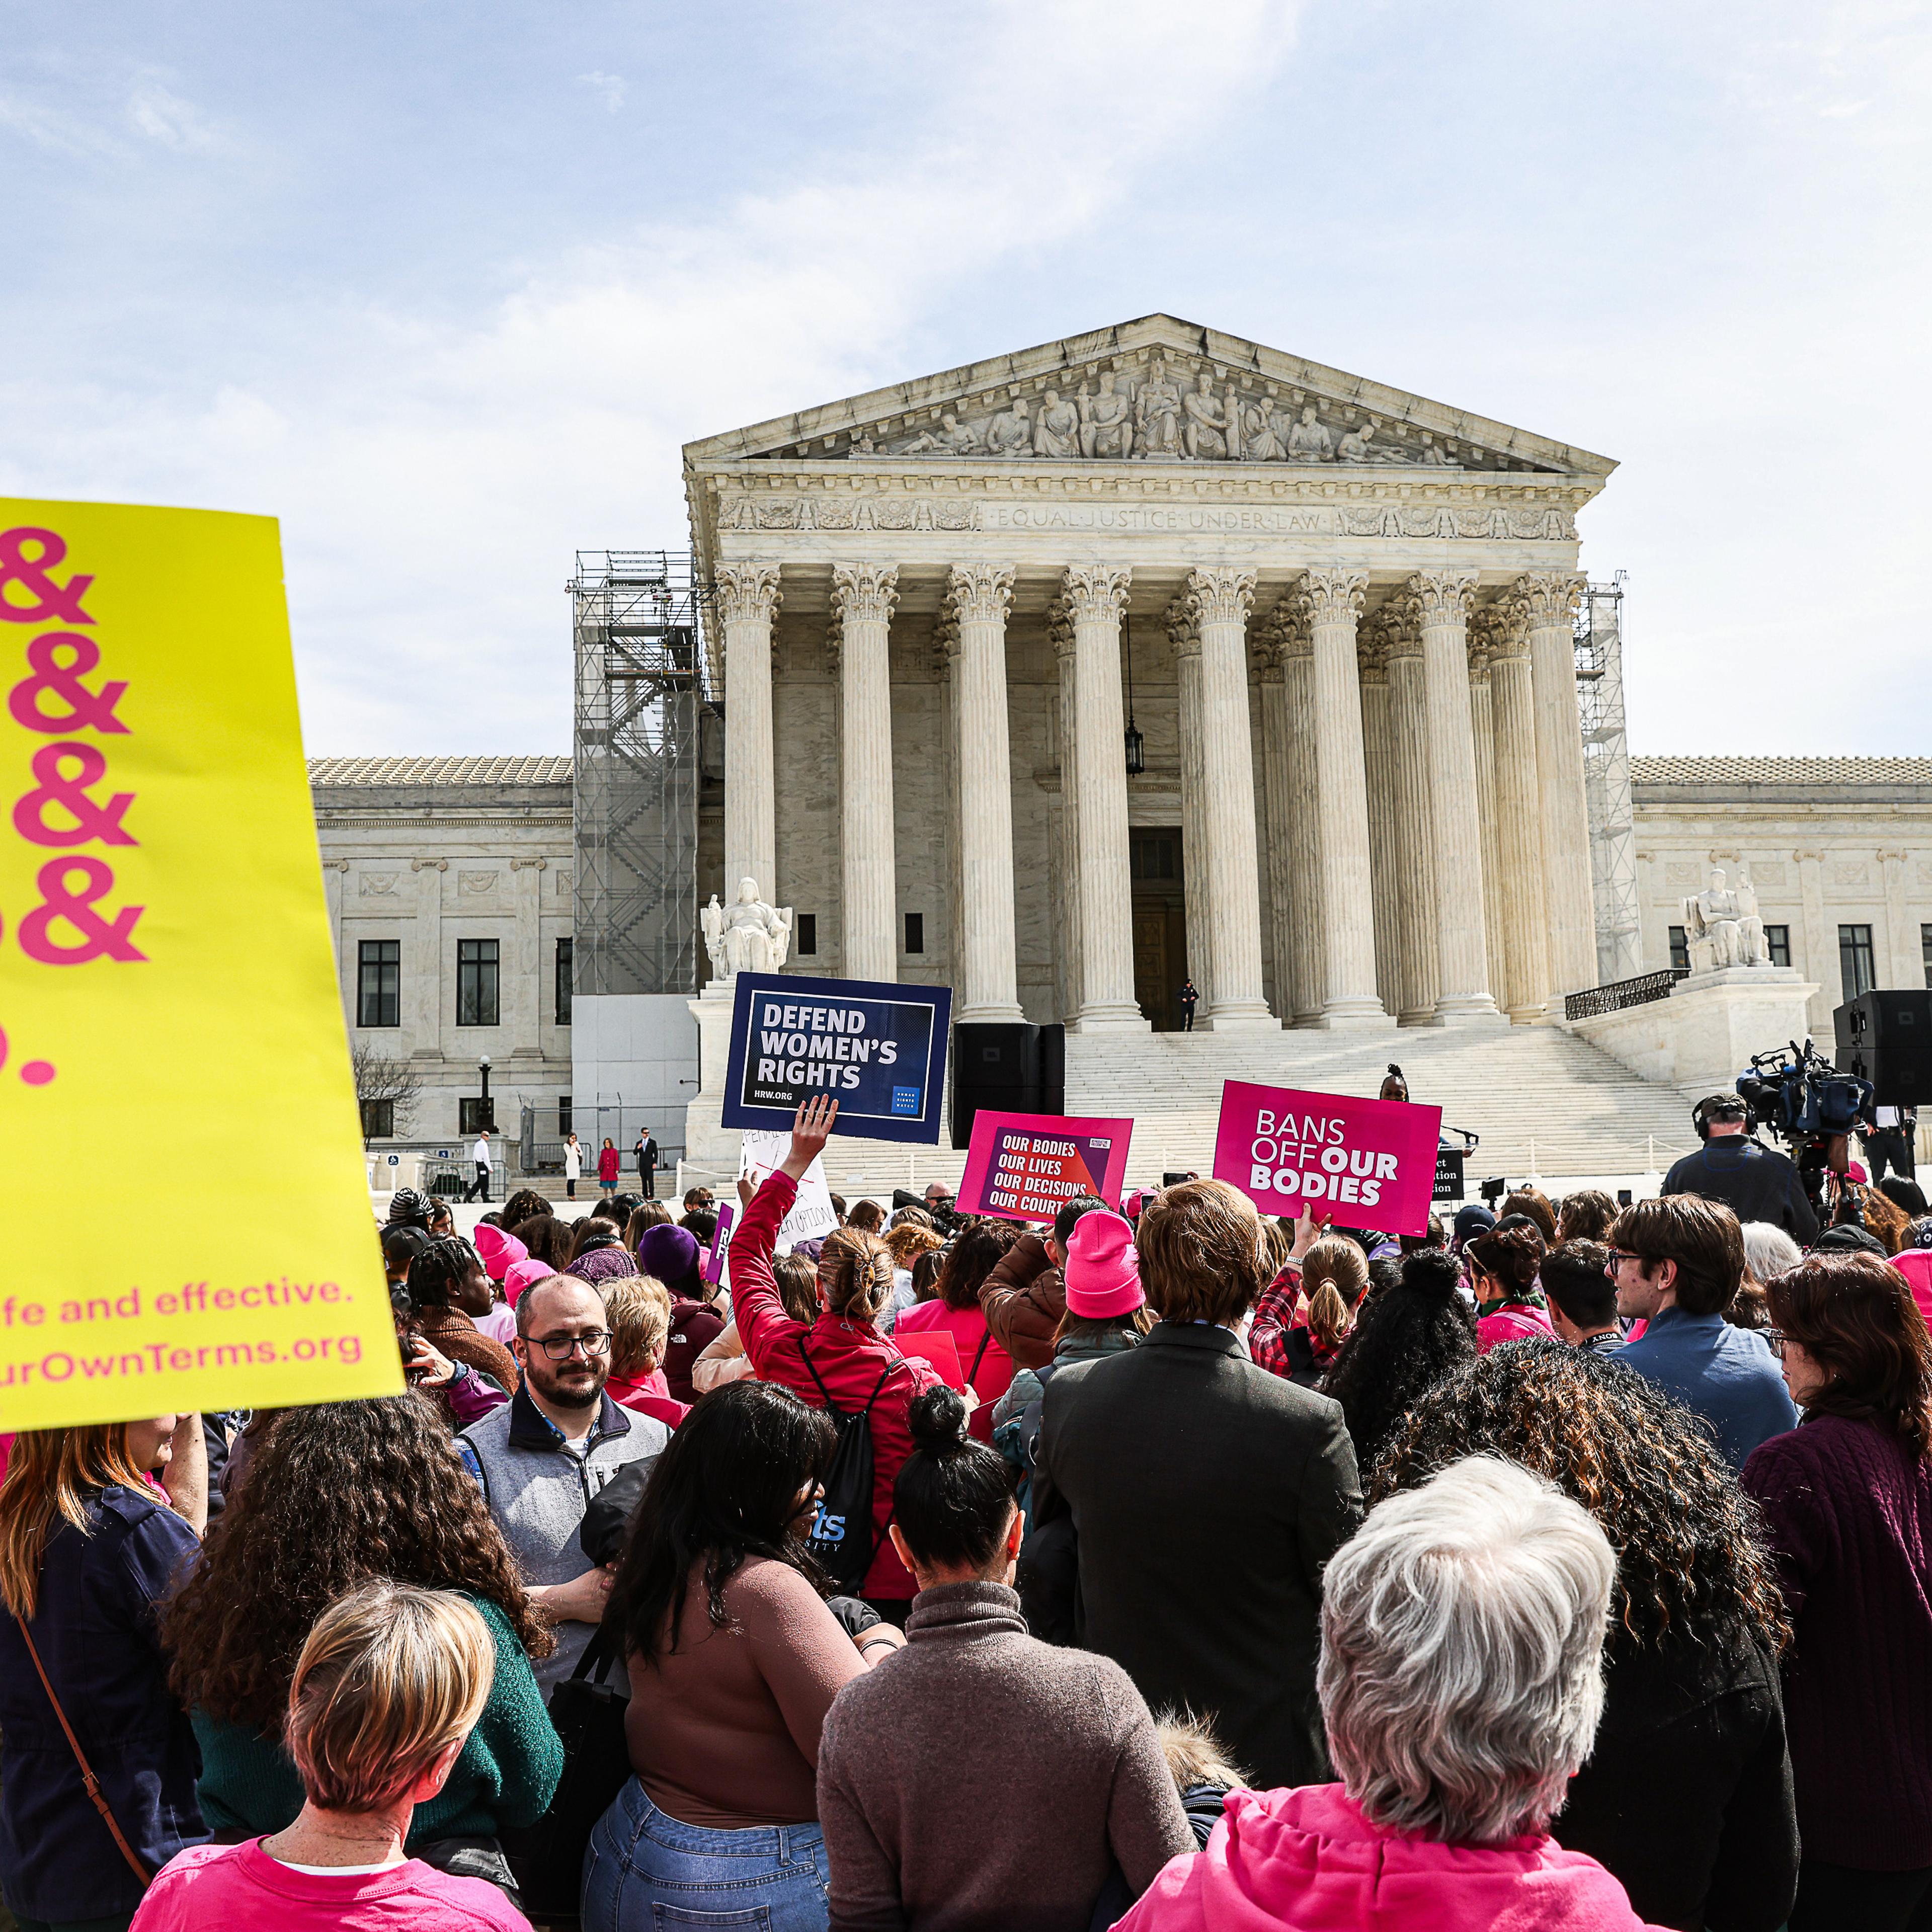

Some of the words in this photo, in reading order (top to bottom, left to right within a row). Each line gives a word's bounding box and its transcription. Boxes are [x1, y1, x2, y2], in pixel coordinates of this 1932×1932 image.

[999, 509, 1079, 527] EQUAL
[1084, 510, 1177, 528] JUSTICE
[1189, 512, 1269, 529] UNDER
[1276, 513, 1320, 530] LAW
[9, 631, 131, 734] &
[13, 742, 139, 848] &
[763, 1004, 865, 1034] DEFEND
[760, 1030, 898, 1064] WOMEN'S
[757, 1058, 860, 1089] RIGHTS
[754, 1090, 792, 1100] HRW.ORG
[1256, 1109, 1345, 1145] BANS
[1002, 1135, 1029, 1152] OUR
[1032, 1139, 1076, 1157] BODIES
[998, 1154, 1026, 1171] OUR
[1028, 1158, 1062, 1175] LIVES
[1251, 1137, 1317, 1168] OFF
[1321, 1147, 1398, 1181] OUR
[994, 1172, 1022, 1189] OUR
[1024, 1177, 1087, 1197] DECISIONS
[1249, 1163, 1382, 1206] BODIES
[1433, 1170, 1457, 1180] tion
[989, 1191, 1018, 1209] OUR
[795, 1207, 832, 1232] OPTION
[59, 1285, 142, 1324] and
[153, 1275, 353, 1317] effective.
[1592, 1332, 1619, 1343] SONY
[804, 1540, 841, 1552] SITY
